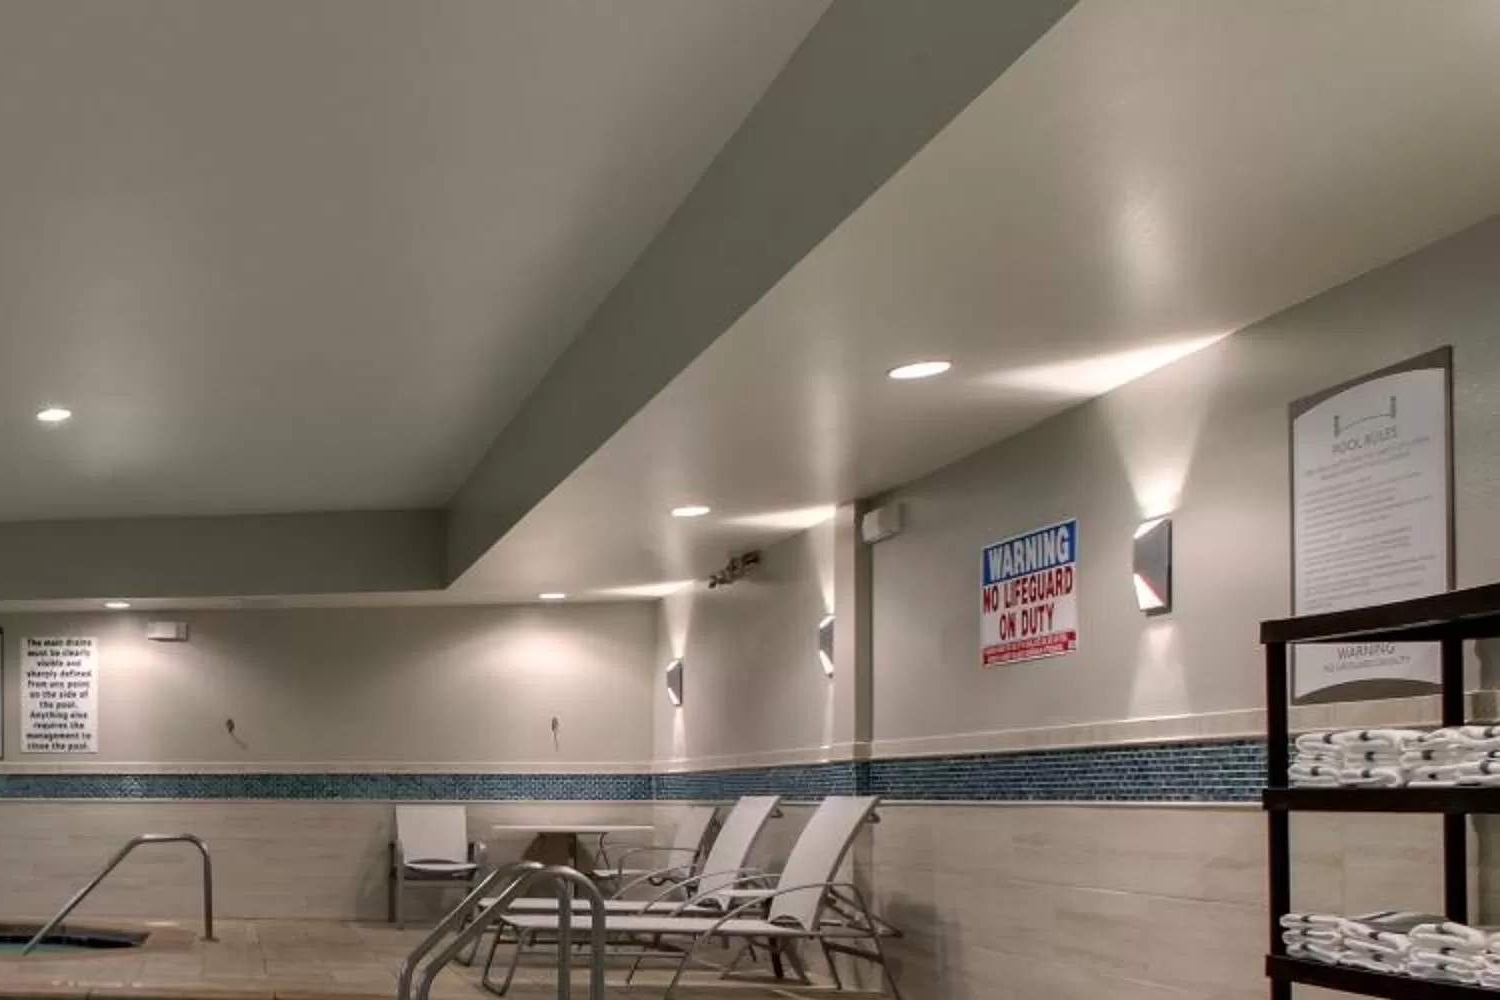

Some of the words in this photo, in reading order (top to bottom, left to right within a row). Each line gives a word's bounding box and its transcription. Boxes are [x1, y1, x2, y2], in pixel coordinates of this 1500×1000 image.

[989, 525, 1069, 580] WARNING
[982, 585, 998, 614] NO
[1005, 565, 1073, 608] LIFEGUARD
[1000, 611, 1015, 640] ON
[1022, 602, 1055, 636] DUTY
[27, 638, 41, 648] The
[37, 658, 63, 667] visible
[67, 659, 81, 667] and
[27, 669, 56, 680] sharply
[61, 668, 91, 677] defined
[43, 690, 56, 698] the
[60, 690, 76, 698] side
[40, 701, 53, 709] the
[30, 711, 68, 721] Anything
[26, 732, 78, 742] management
[52, 742, 65, 750] the
